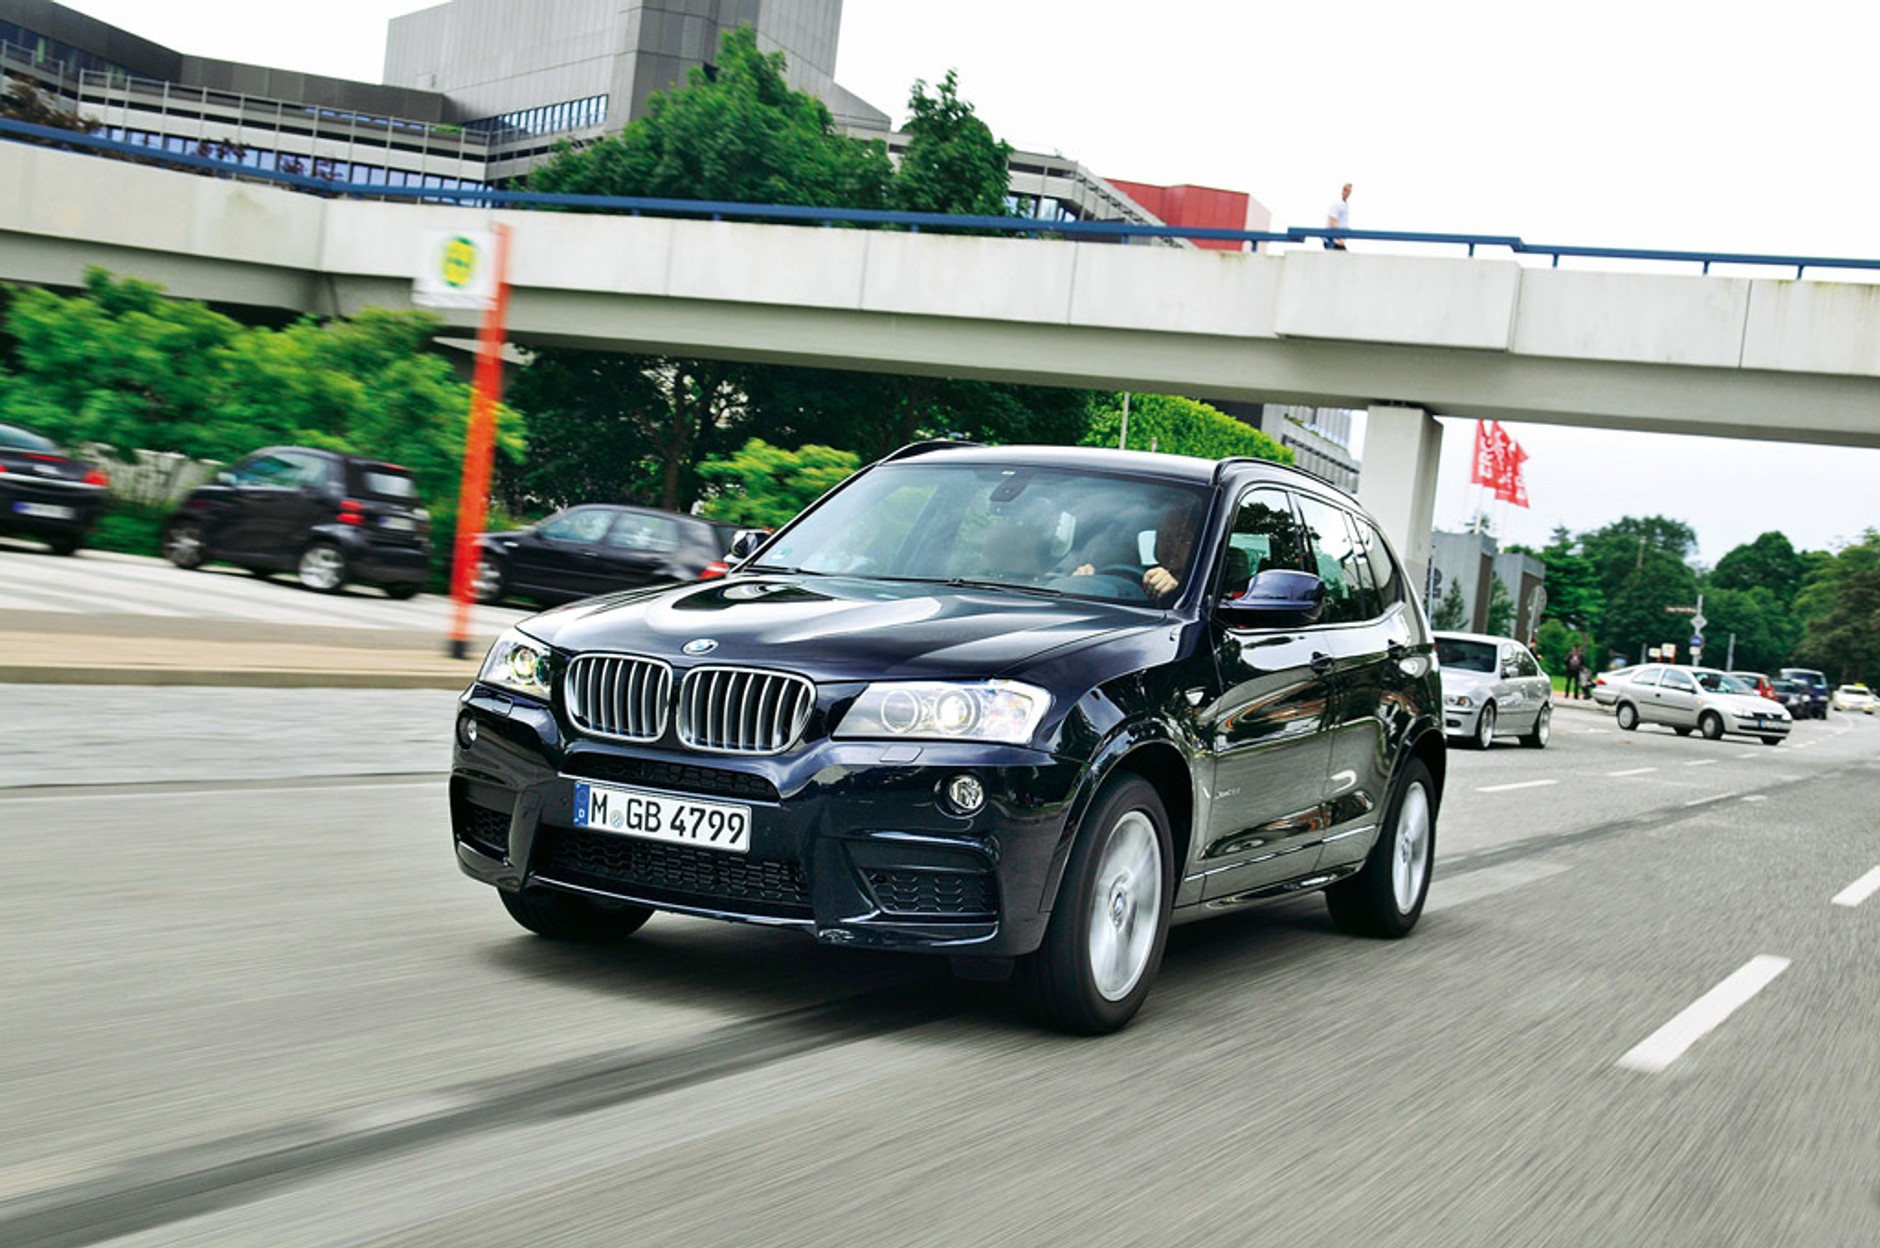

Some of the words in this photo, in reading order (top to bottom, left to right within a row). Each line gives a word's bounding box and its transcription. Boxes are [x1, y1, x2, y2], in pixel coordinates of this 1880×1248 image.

[591, 792, 607, 824] M
[626, 798, 661, 832] GB
[670, 806, 745, 844] 4799
